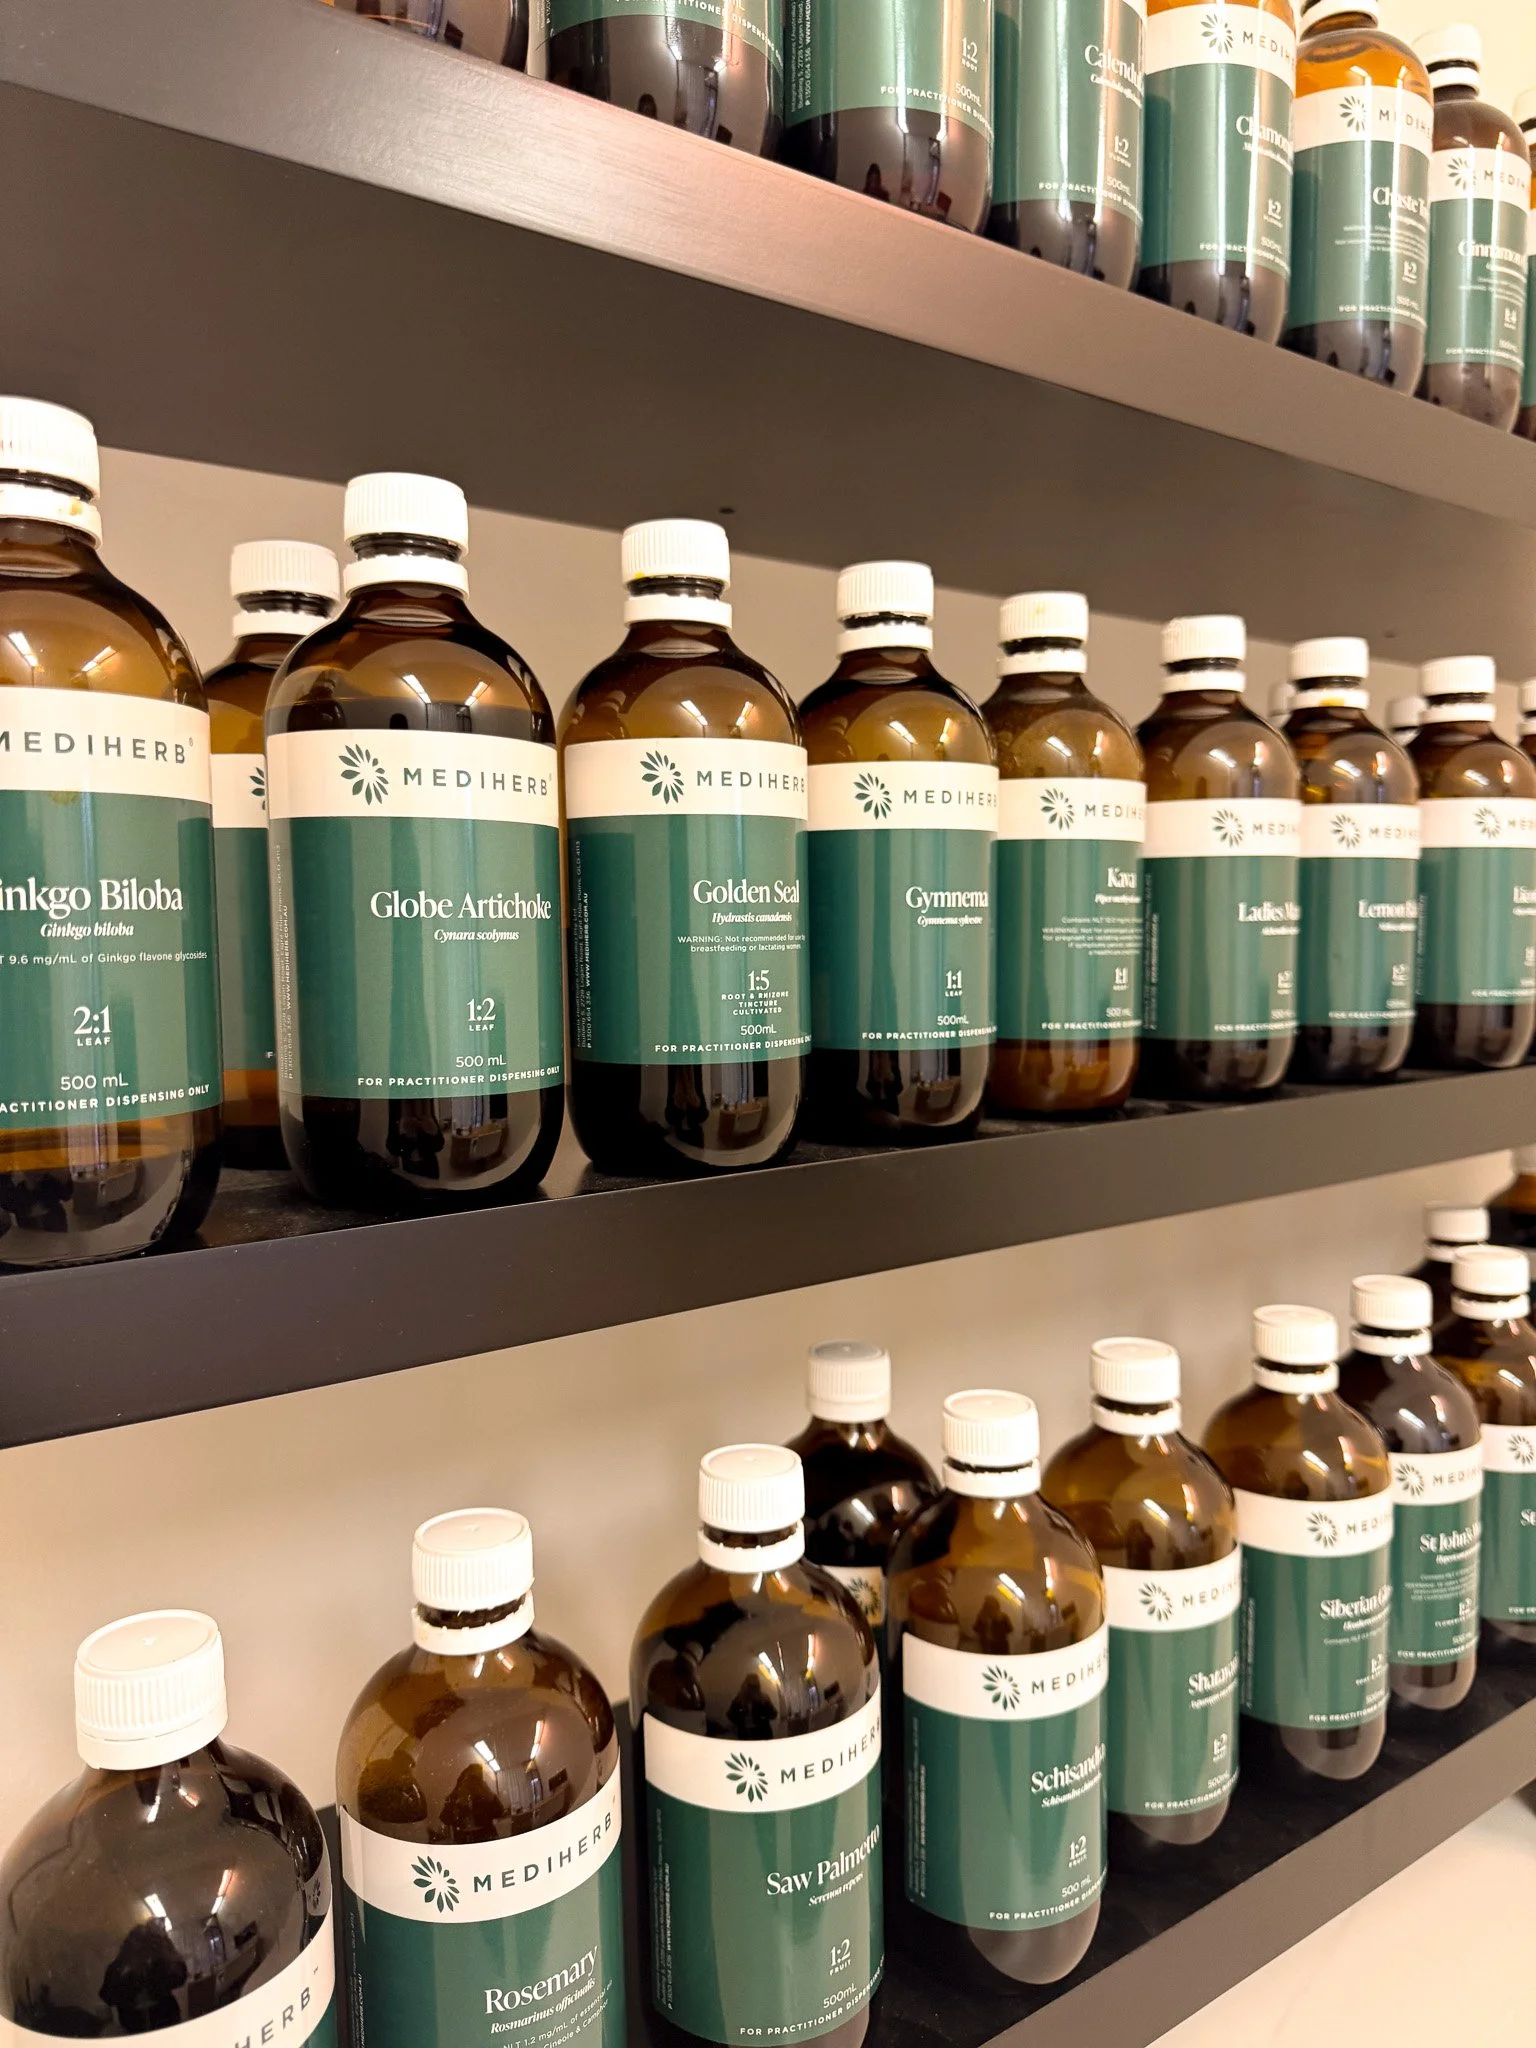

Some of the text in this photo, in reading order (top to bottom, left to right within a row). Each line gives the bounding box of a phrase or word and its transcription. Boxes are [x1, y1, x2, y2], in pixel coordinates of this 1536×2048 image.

[962, 37, 978, 64] 1:2
[954, 82, 982, 107] 500mL
[0, 876, 184, 920] inkgo Biloba
[693, 878, 800, 904] Golden Seal
[905, 886, 989, 914] Gymnema
[370, 889, 552, 920] Globe Artichoke
[712, 912, 756, 926] Hydrastis
[40, 922, 134, 940] Ginkgo biloba
[434, 928, 520, 944] Cynara scolymus
[677, 935, 723, 944] WARNING:
[742, 934, 786, 942] recommended
[8, 954, 28, 965] 9.6
[33, 954, 78, 966] mg/mL
[82, 954, 94, 964] of
[98, 954, 136, 965] Ginkgo
[139, 952, 173, 962] flavone
[174, 951, 208, 962] glycosides
[690, 944, 747, 953] breastfeeding
[758, 944, 786, 952] lactating
[748, 969, 770, 991] 1:5
[945, 970, 962, 990] 1:1
[738, 1000, 778, 1008] TINCTURE
[758, 991, 790, 999] RHIZOME
[73, 1004, 112, 1035] 2:1
[466, 996, 496, 1022] 1:2
[732, 1008, 782, 1016] CULTIVATED
[468, 1024, 495, 1032] LEAF
[740, 1024, 777, 1036] 500mL
[936, 1014, 970, 1026] 500mL
[76, 1036, 111, 1047] LEAF
[862, 1032, 882, 1040] FOR
[886, 1030, 956, 1040] PRACTITIONER
[654, 1044, 678, 1052] FOR
[682, 1042, 762, 1052] PRACTITIONER
[456, 1054, 507, 1068] 500 mL
[60, 1072, 129, 1091] 500 mL
[357, 1076, 383, 1086] FOR
[388, 1074, 485, 1086] PRACTITIONER
[489, 1068, 546, 1083] DISPENSING
[0, 1084, 210, 1114] ACTITIONER DISPENSING ONLY
[474, 1812, 612, 1892] MEDIHERB
[1070, 1835, 1087, 1861] 1:2
[766, 1824, 880, 1896] Saw Palmetto
[1061, 1874, 1092, 1898] 500 mL
[989, 1896, 1080, 1920] FOR PRACTITIONER
[830, 1938, 851, 1966] 1:2
[829, 1959, 852, 1976] FRUIT
[484, 1946, 598, 2014] Rosemary
[490, 1977, 596, 2034] Rosmarinus officinalis
[823, 1982, 857, 2009] 500mL
[524, 1990, 606, 2048] 1.2 mg/mL of essential
[576, 2025, 582, 2034] &
[740, 2026, 762, 2036] FOR
[768, 2008, 843, 2036] PRACTITIONER
